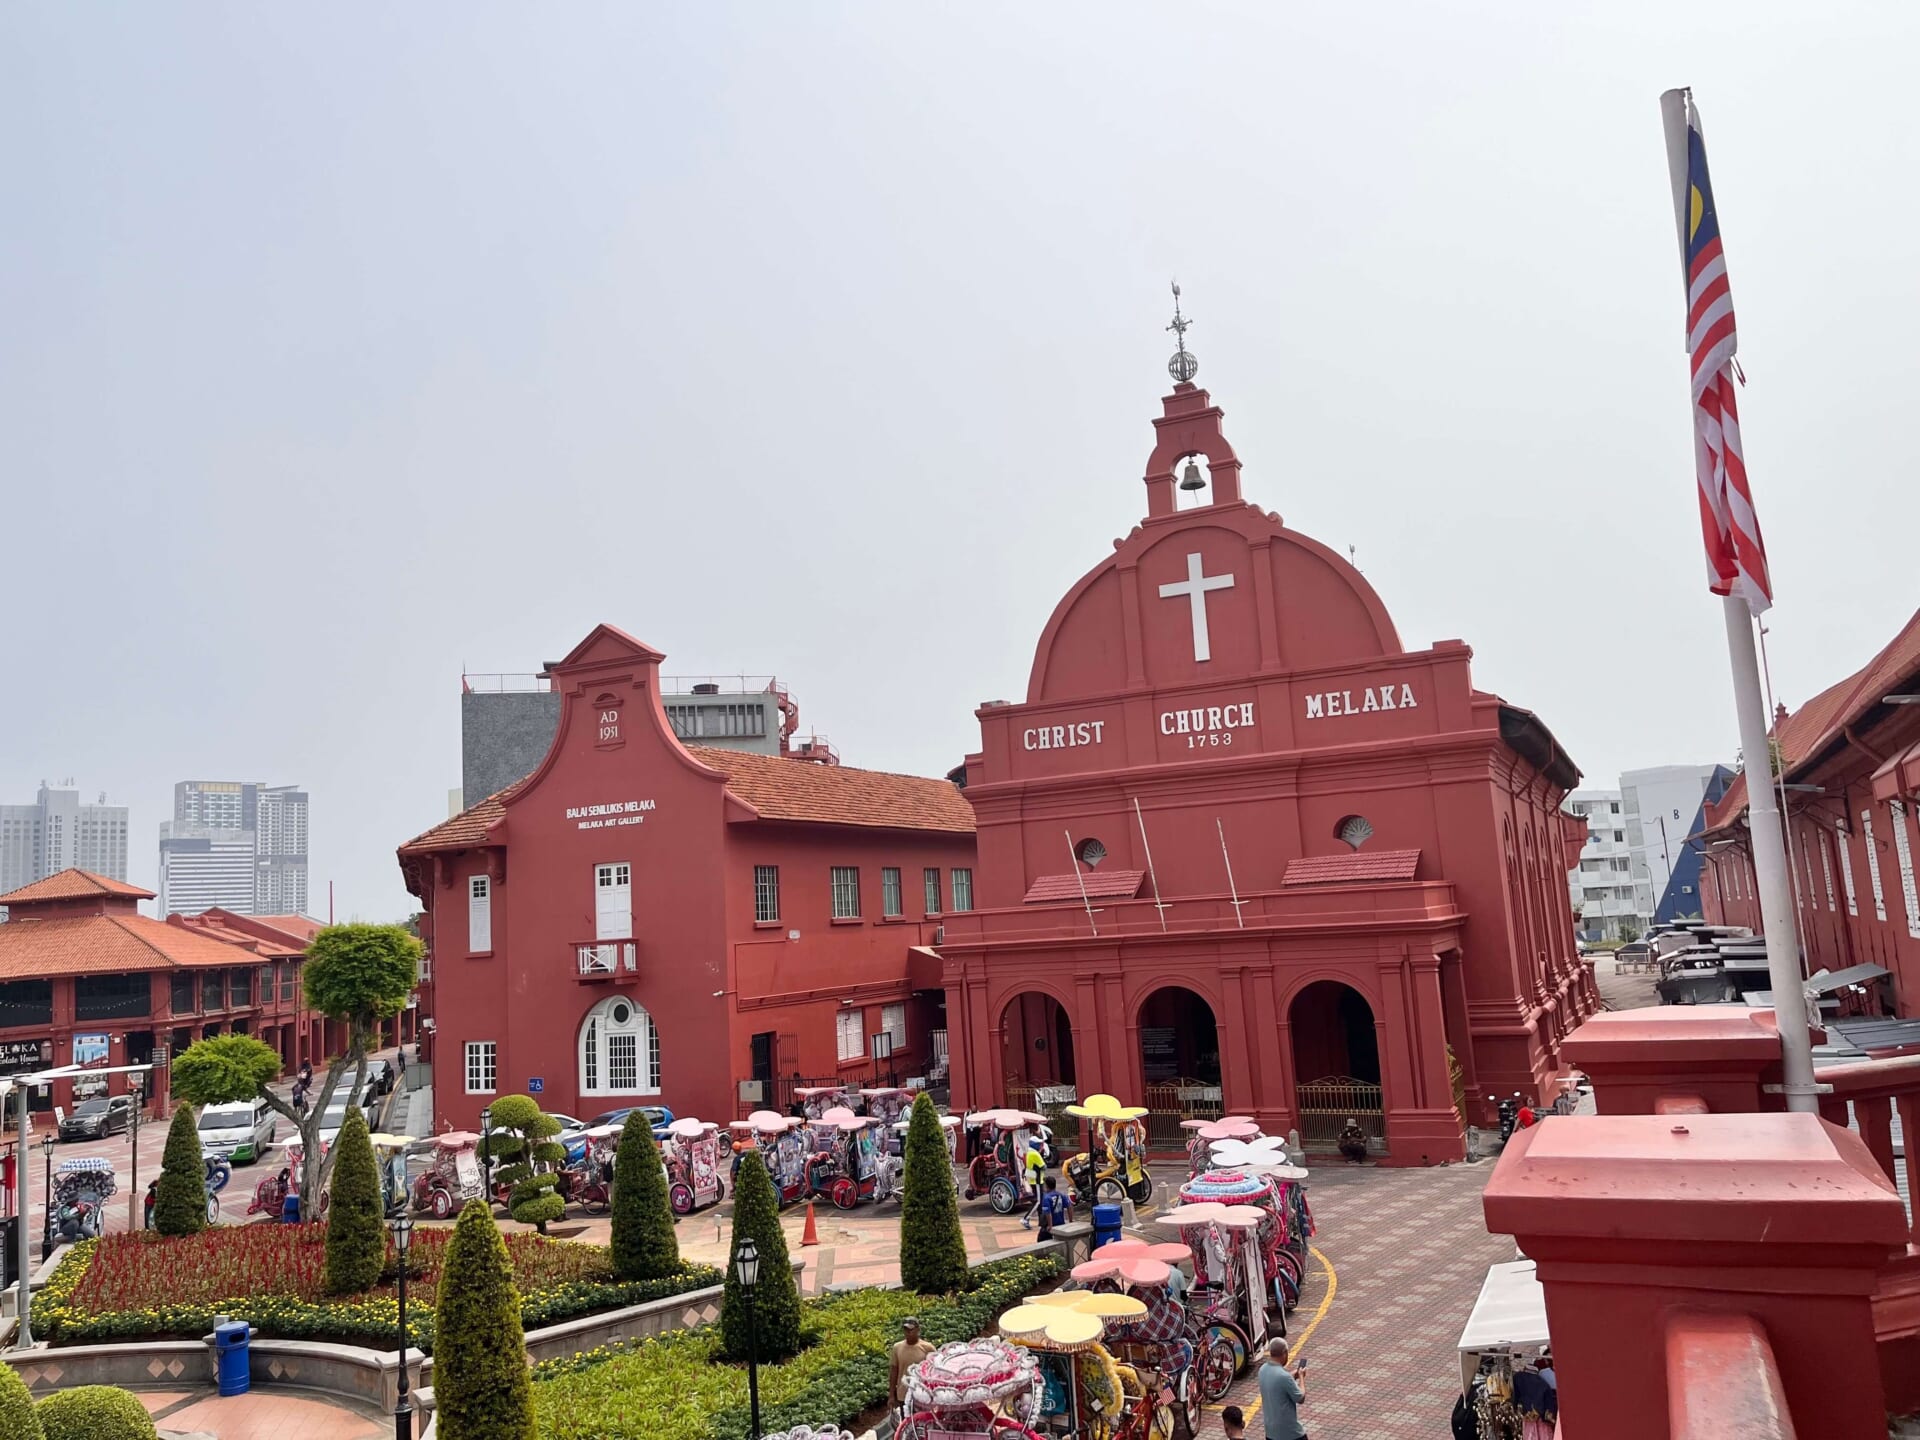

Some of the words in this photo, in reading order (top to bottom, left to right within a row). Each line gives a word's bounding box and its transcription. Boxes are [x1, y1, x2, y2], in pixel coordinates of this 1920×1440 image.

[600, 710, 618, 724] AD
[1023, 720, 1105, 751] CHRIST
[1160, 702, 1255, 735] CHURCH
[1305, 683, 1417, 719] MELAKA
[600, 725, 618, 741] 1931
[1188, 732, 1232, 749] 1753
[566, 807, 588, 819] BALAI
[588, 802, 624, 816] SENILUKIS
[624, 799, 656, 812] MELAKA
[1673, 809, 1680, 820] B
[578, 820, 604, 830] MELAKA
[604, 818, 617, 827] ART
[618, 815, 644, 825] GALLERY
